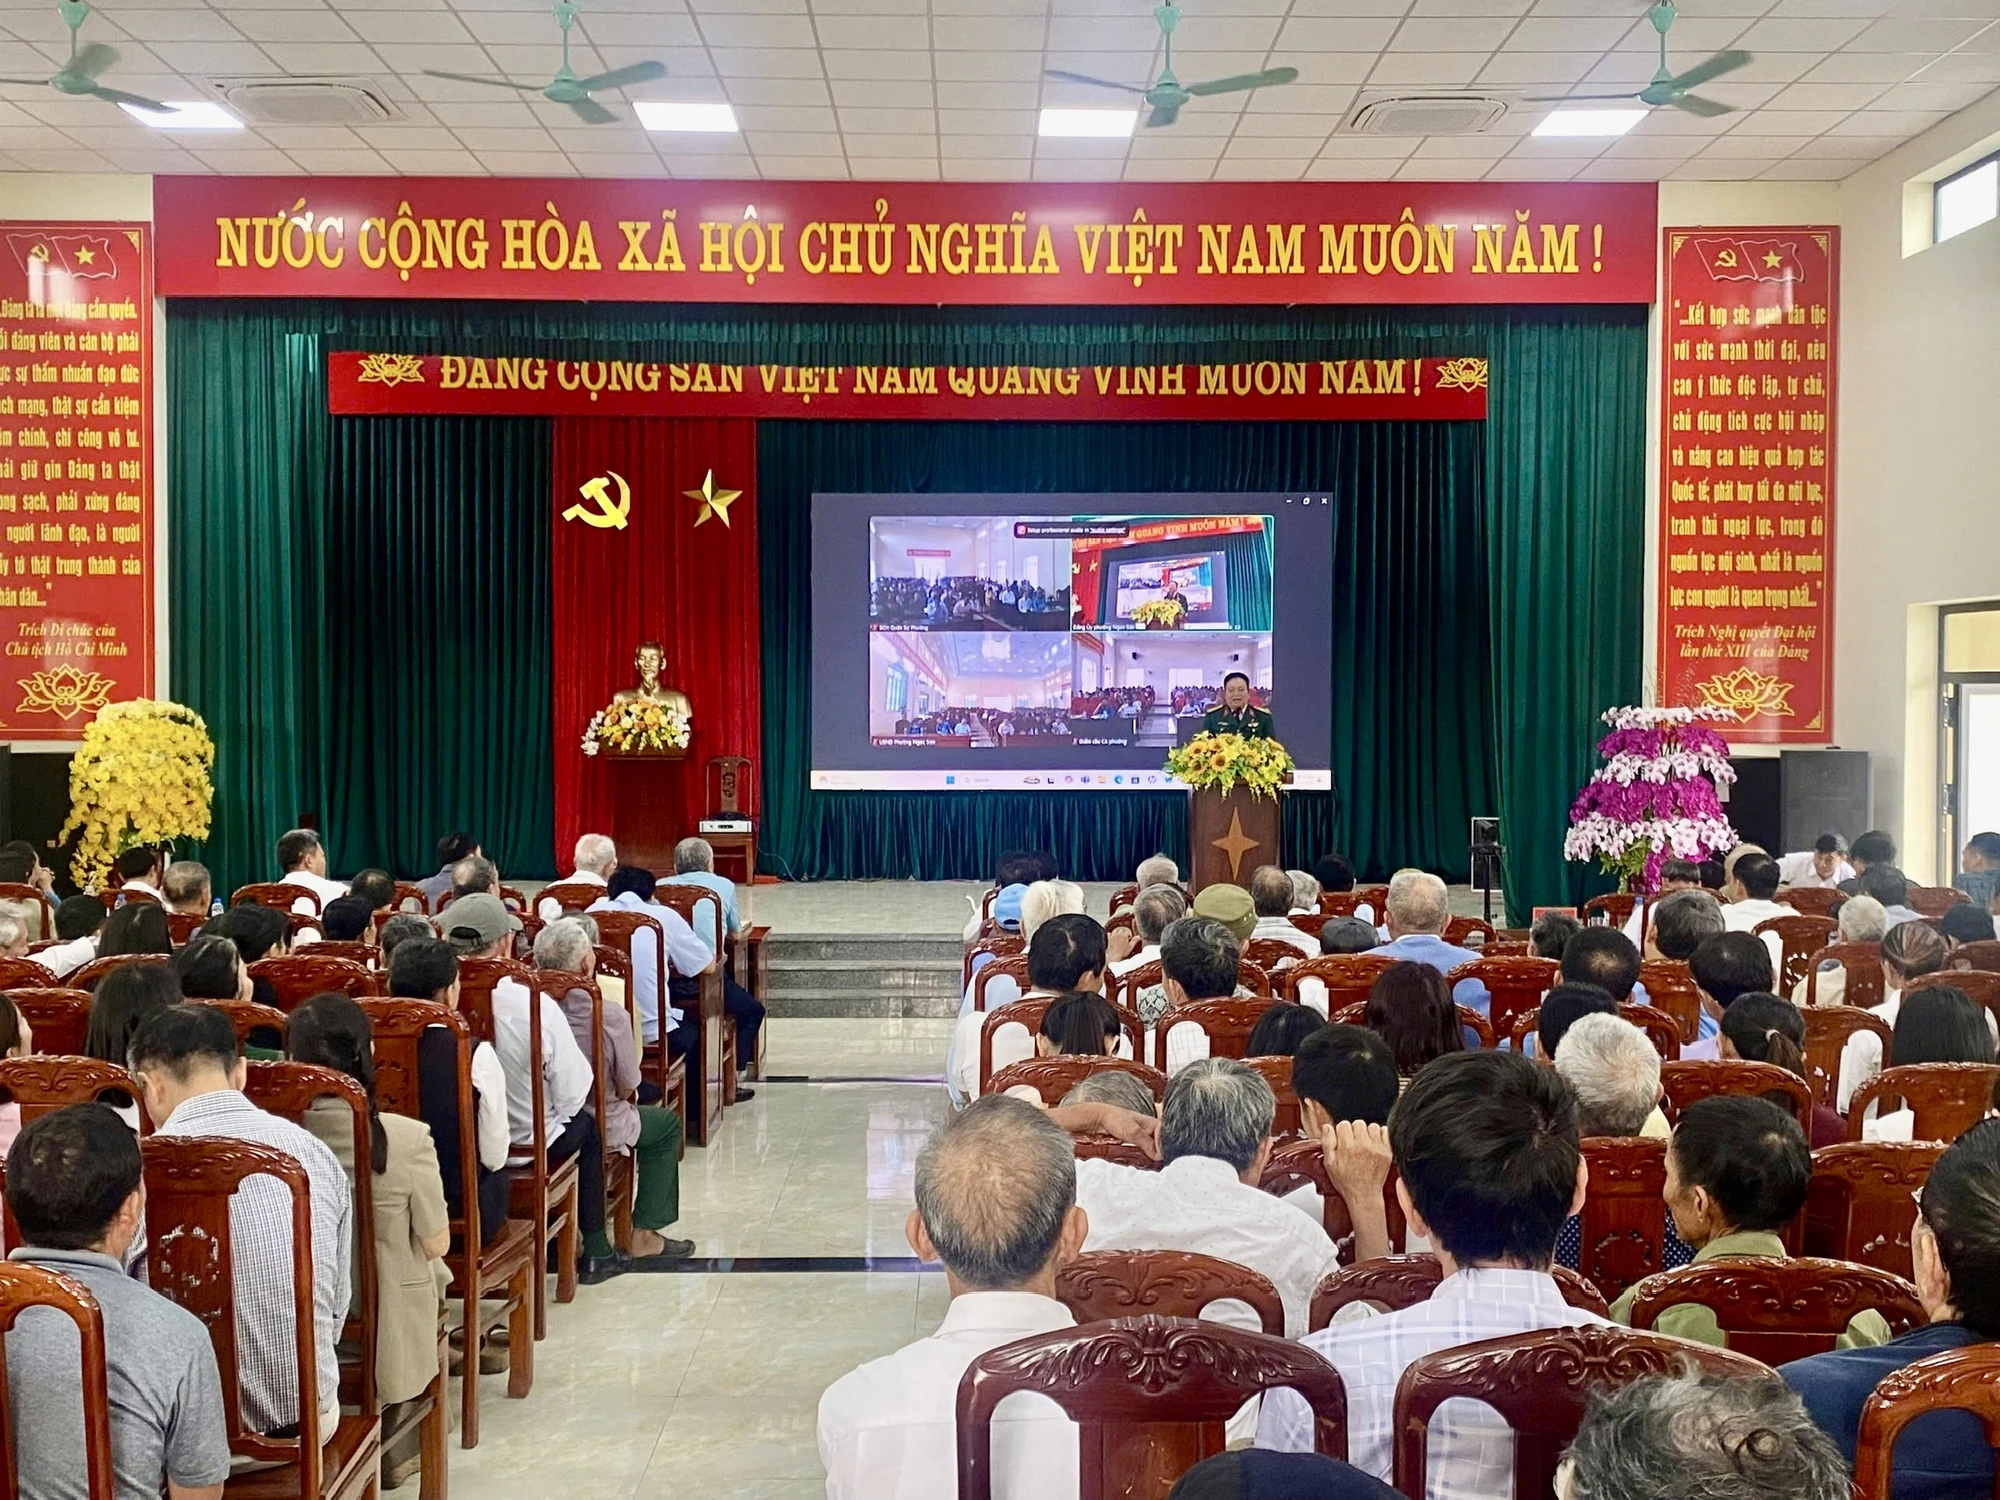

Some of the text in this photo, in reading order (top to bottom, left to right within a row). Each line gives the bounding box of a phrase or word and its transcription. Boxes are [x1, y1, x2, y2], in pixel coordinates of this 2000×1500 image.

[215, 197, 1603, 287] NƯỚC CỘNG HÒA XÃ HỘI CHỦ NGHĨA VIỆT NAM MUÔN NĂM !
[1710, 305, 1727, 329] hợp
[1733, 304, 1750, 325] sức
[1811, 304, 1826, 329] tộc
[11, 328, 139, 355] đảng viên và cán bộ phải
[1674, 339, 1826, 365] với sức mạnh thời đại, nêu
[15, 366, 28, 386] sự
[97, 366, 116, 387] đạo
[120, 366, 139, 383] đức
[853, 365, 938, 394] NAM
[948, 365, 1080, 398] QUANG
[1094, 363, 1186, 395] VINH
[1413, 358, 1422, 397] !
[1673, 372, 1825, 400] cao ý thức độc lập, tự chủ,
[18, 399, 48, 419] mạng,
[53, 396, 72, 419] thật
[75, 399, 88, 419] sự
[114, 396, 139, 419] kiệm
[1673, 407, 1825, 435] chủ động tích cực hội nhập
[19, 428, 49, 449] chính,
[55, 428, 71, 446] chí
[78, 428, 102, 449] công
[1672, 444, 1684, 466] và
[1716, 448, 1734, 466] cao
[1739, 444, 1759, 470] hiệu
[1765, 442, 1782, 468] quả
[1787, 445, 1804, 470] hợp
[1809, 444, 1824, 466] tác
[21, 457, 140, 483] giữ gìn Đảng ta thật
[23, 490, 140, 515] sạch, phải xứng đáng
[1672, 476, 1694, 503] Quốc
[1714, 480, 1733, 503] phát
[1737, 480, 1753, 504] huy
[1773, 480, 1785, 502] đa
[1788, 480, 1803, 506] nội
[7, 522, 140, 547] người lãnh đạo, là người
[1671, 513, 1823, 540] tranh thủ ngoại lực, trong đó
[15, 553, 140, 579] tớ thật trung thành của
[1701, 551, 1715, 576] lực
[1718, 551, 1733, 576] nội
[1736, 551, 1758, 574] sinh,
[1783, 551, 1792, 572] là
[1670, 585, 1788, 611] lực con người là quan trọng
[18, 622, 47, 637] Trích
[66, 622, 93, 637] chúc
[95, 622, 116, 637] của
[1674, 624, 1705, 639] Trích
[1708, 625, 1737, 642] Nghị
[1773, 625, 1794, 642] Đại
[1797, 625, 1816, 642] hội
[5, 640, 29, 656] Chủ
[31, 642, 51, 659] tịch
[55, 638, 72, 656] Hồ
[97, 641, 127, 656] Minh
[1680, 639, 1809, 661] lần thứ XIII của Đảng
